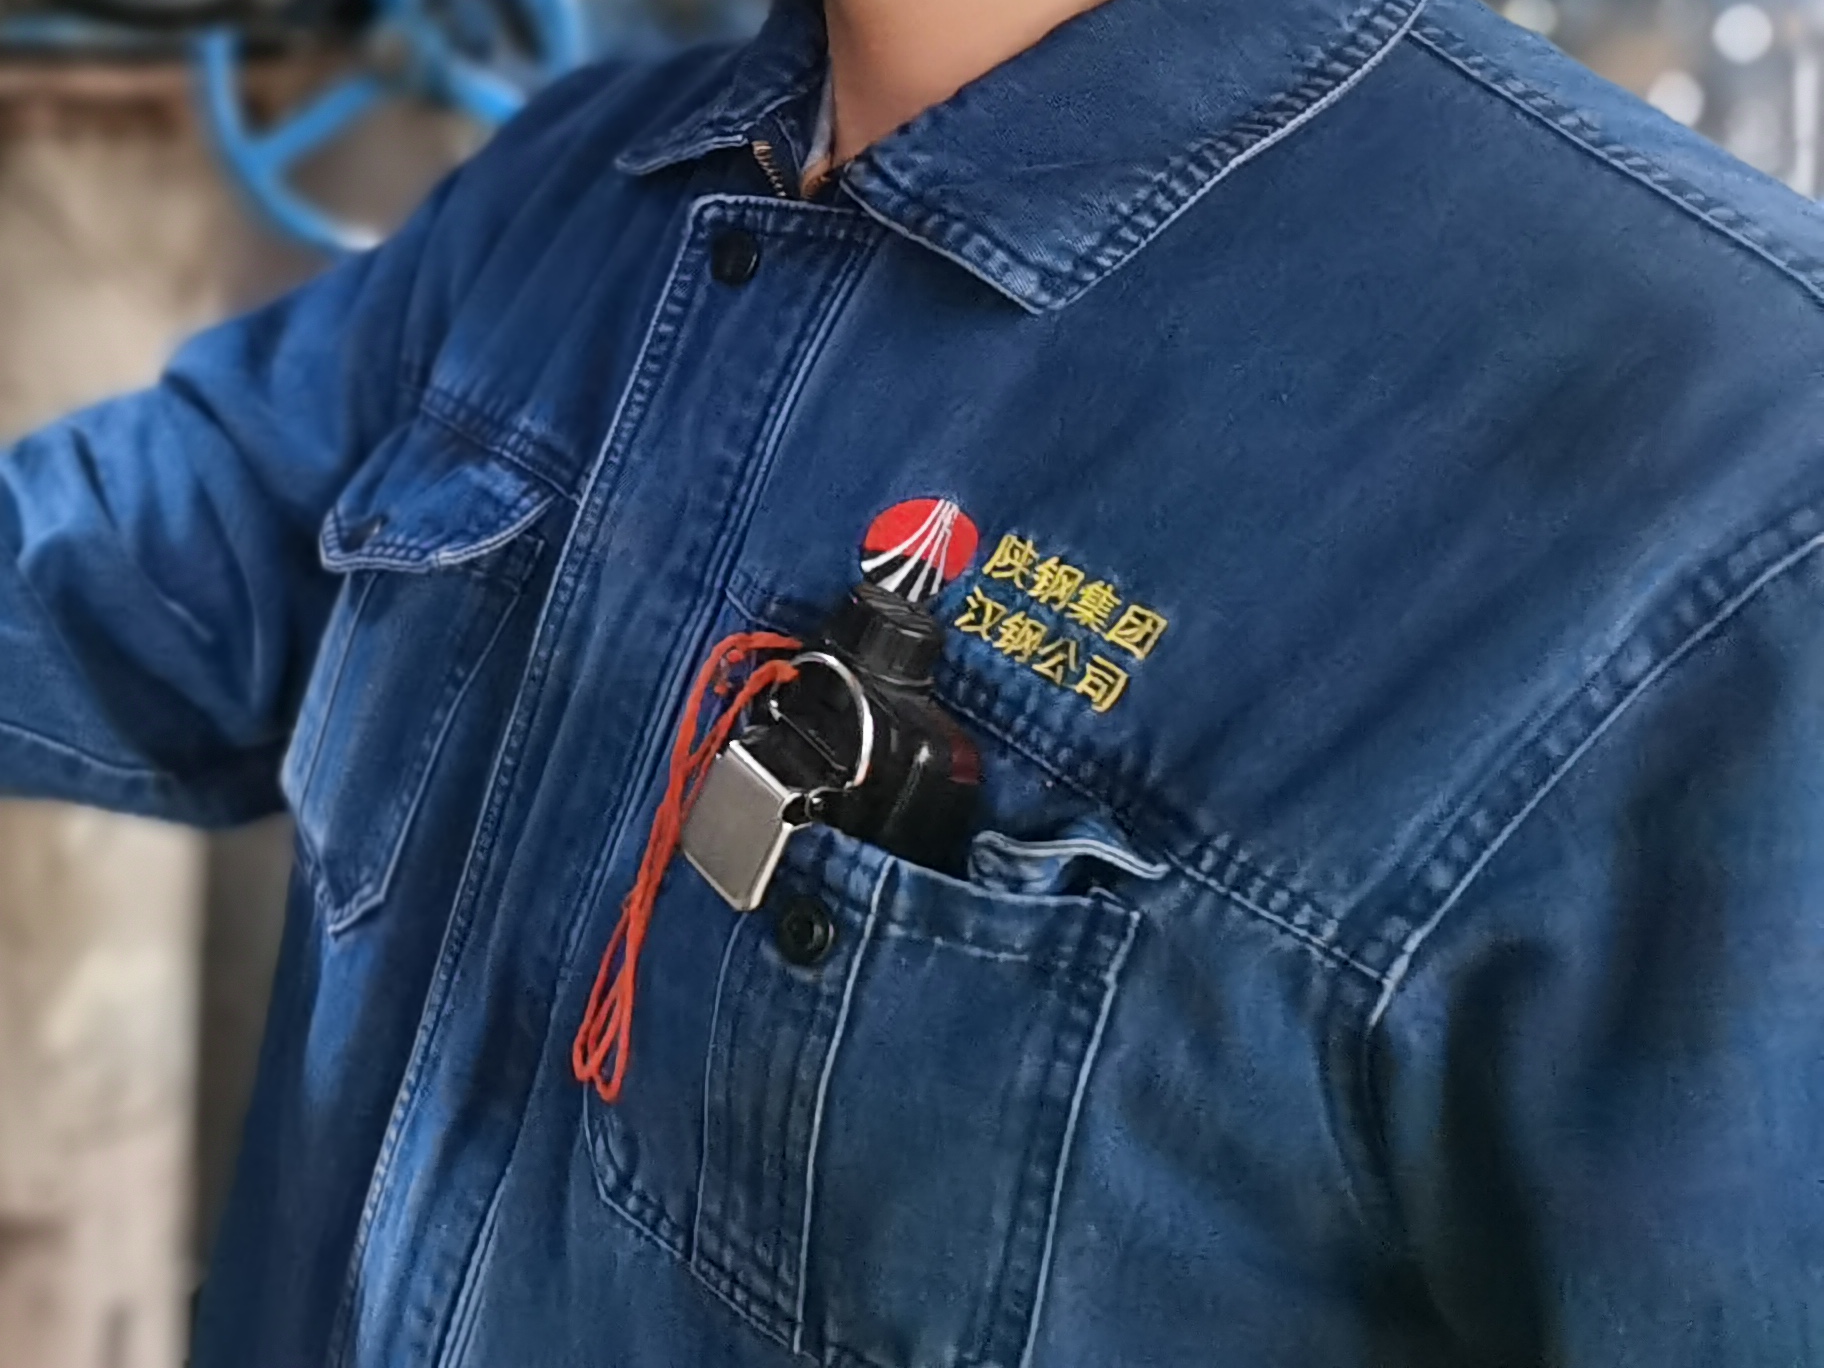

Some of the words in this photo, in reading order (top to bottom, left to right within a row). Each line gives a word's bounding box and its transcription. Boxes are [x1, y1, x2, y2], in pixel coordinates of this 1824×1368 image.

[953, 585, 1129, 713] 汉钢公司
[982, 533, 1169, 661] 陕钢集团
